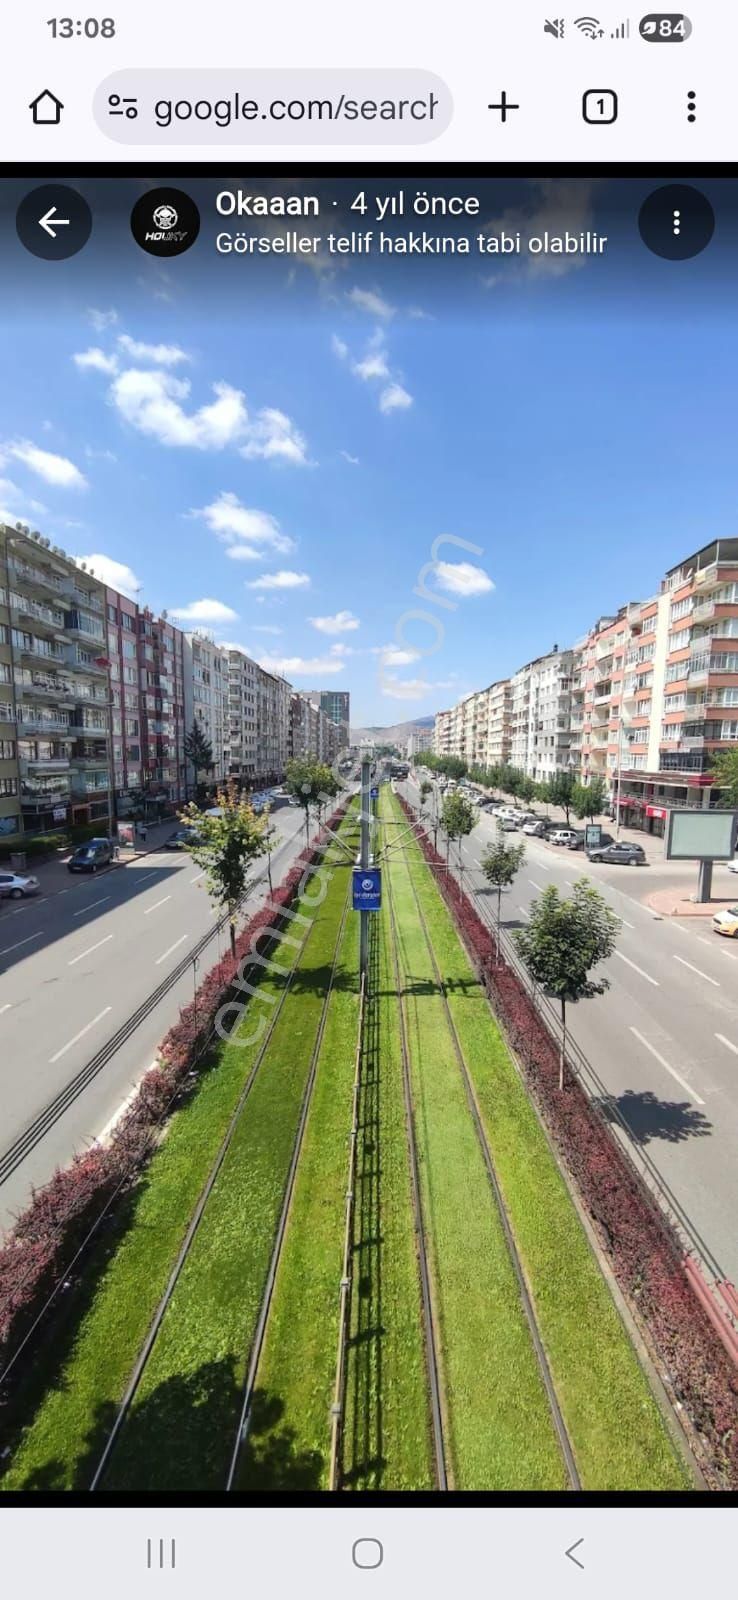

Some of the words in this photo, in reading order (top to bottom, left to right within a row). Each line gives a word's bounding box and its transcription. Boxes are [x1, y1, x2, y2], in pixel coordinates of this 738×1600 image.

[47, 18, 116, 38] 13:08
[659, 19, 686, 37] 84
[154, 93, 439, 128] google.com/search
